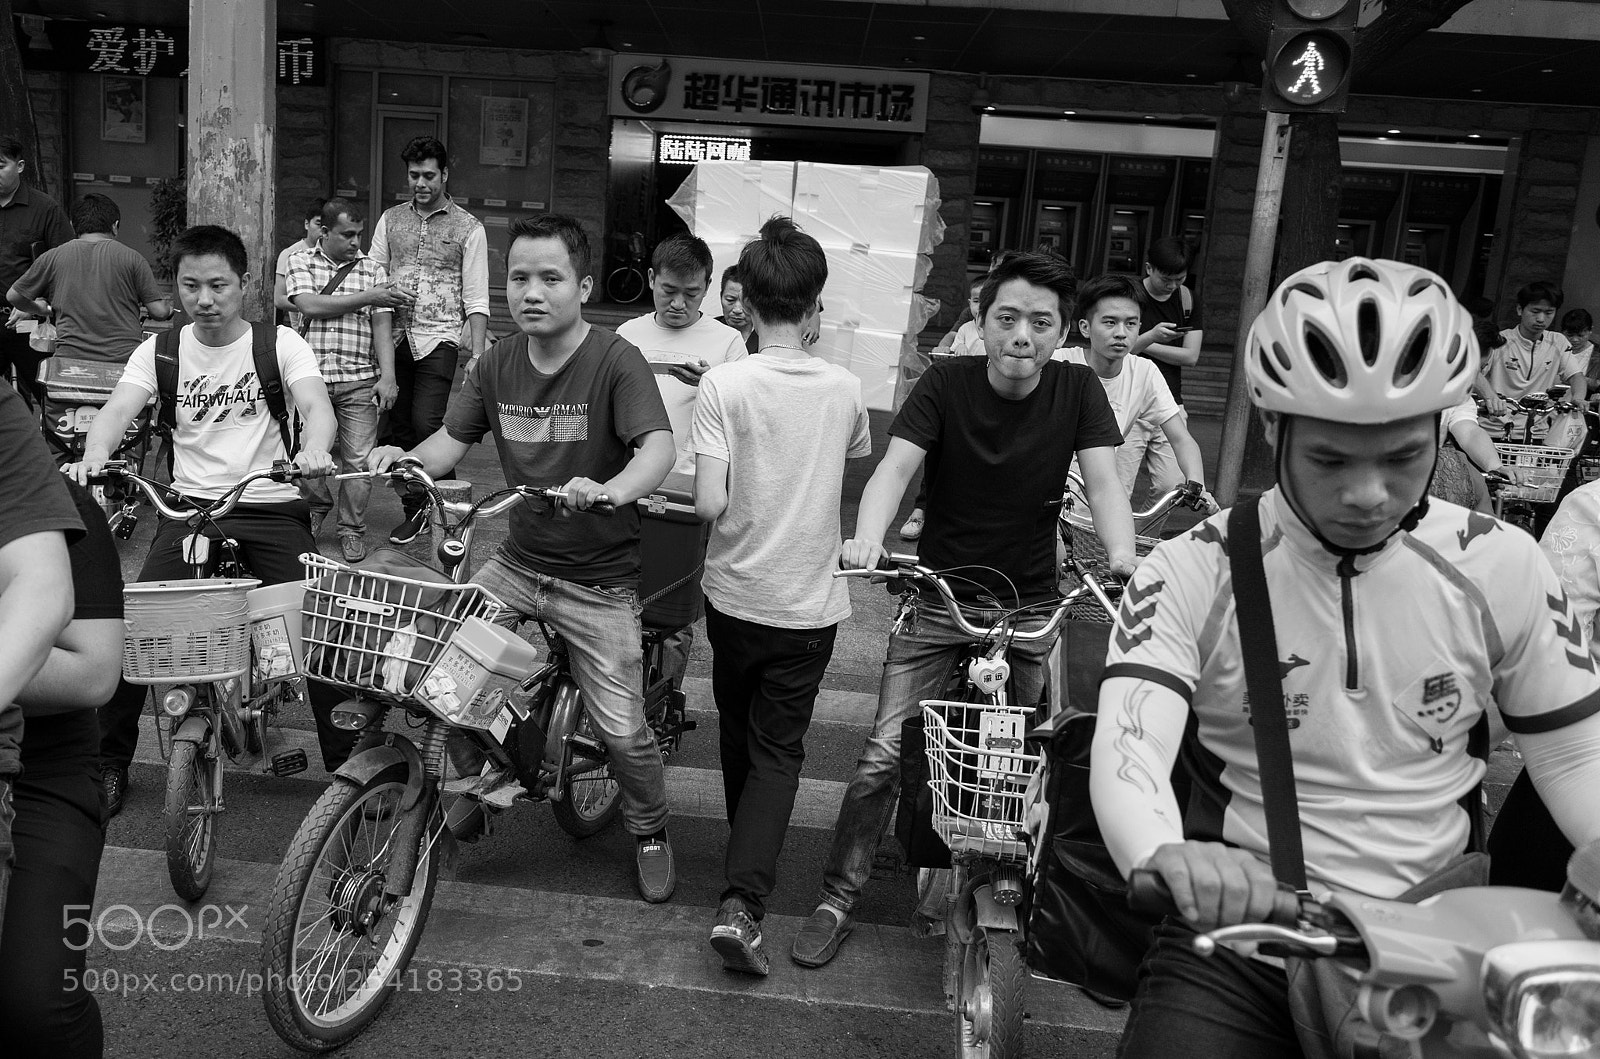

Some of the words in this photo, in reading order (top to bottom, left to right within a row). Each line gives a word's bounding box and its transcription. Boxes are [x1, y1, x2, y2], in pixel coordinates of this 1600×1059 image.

[86, 27, 174, 75] 爱护
[277, 37, 314, 84] 币
[683, 72, 915, 122] 超华通讯市场
[176, 387, 266, 408] FAIRWHALE
